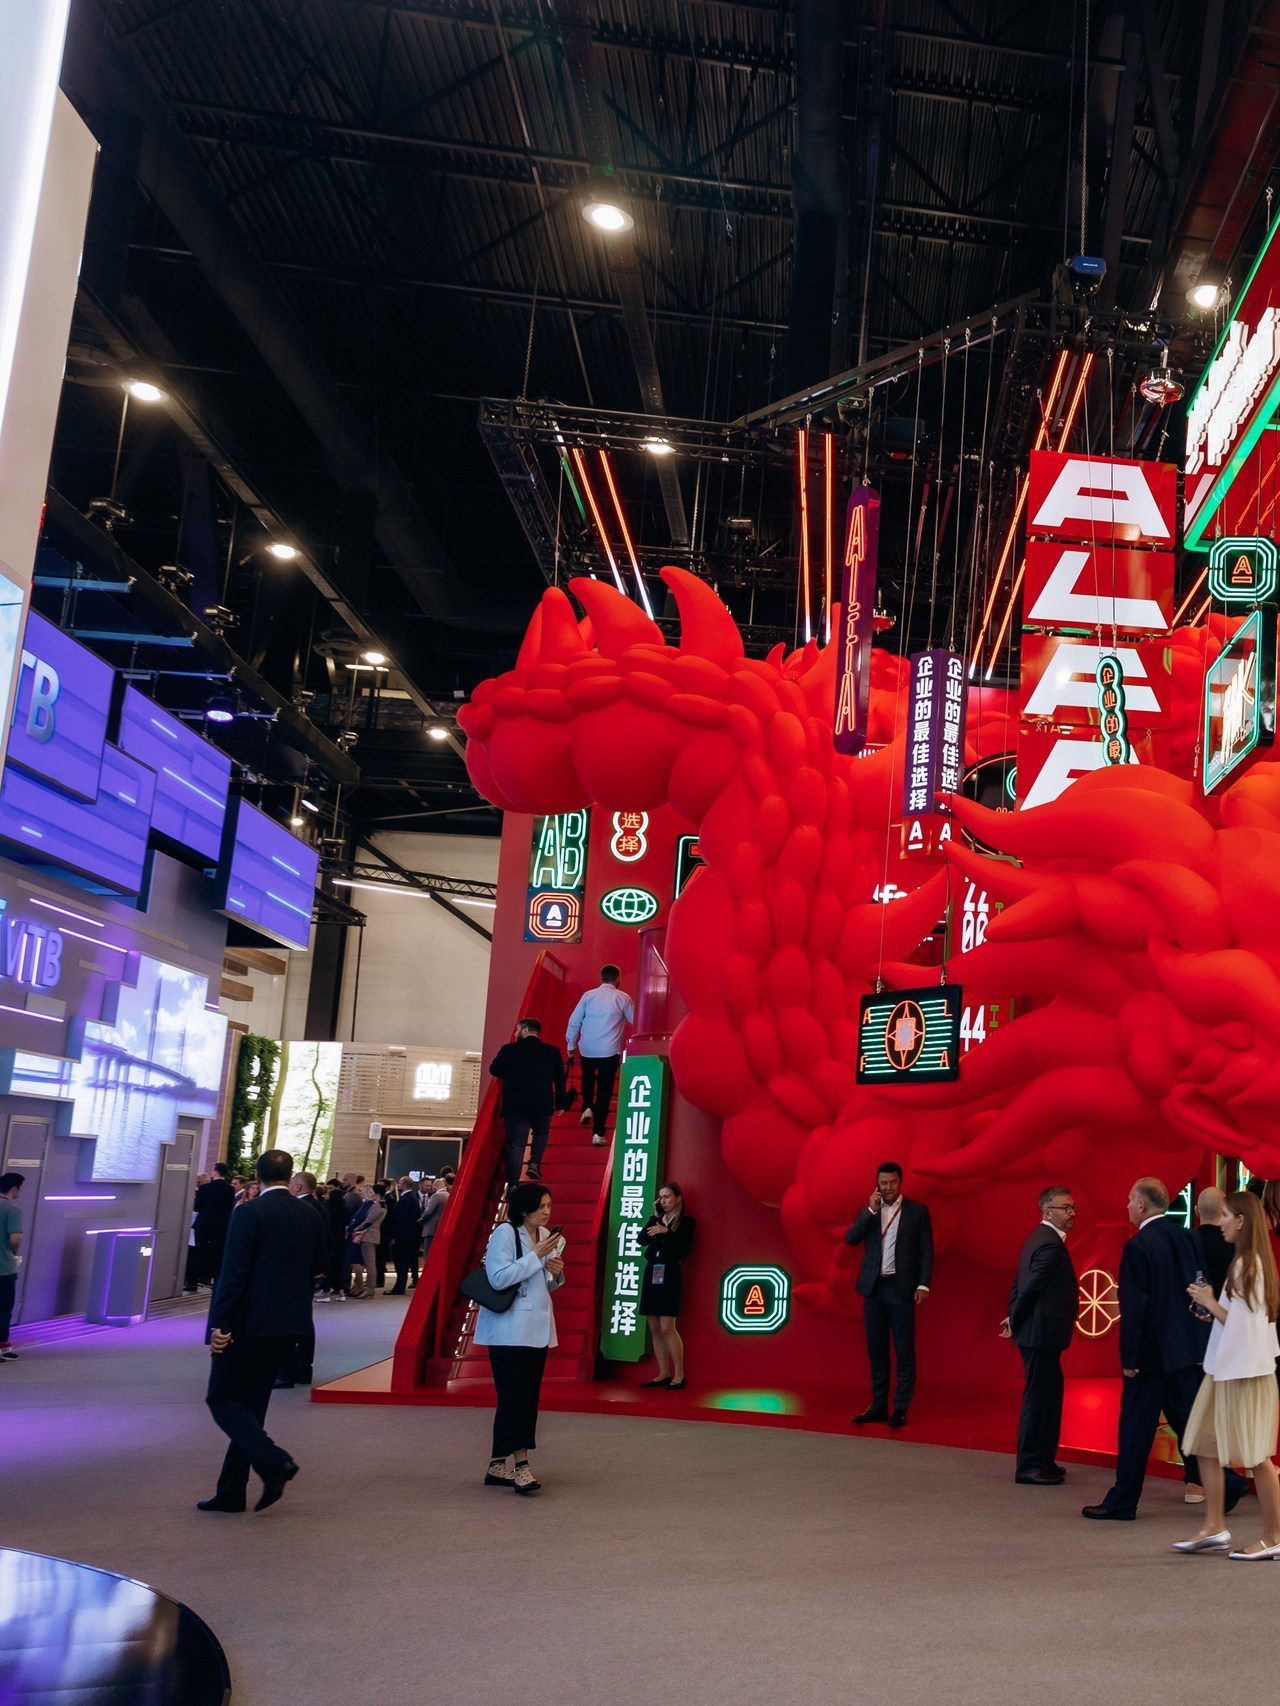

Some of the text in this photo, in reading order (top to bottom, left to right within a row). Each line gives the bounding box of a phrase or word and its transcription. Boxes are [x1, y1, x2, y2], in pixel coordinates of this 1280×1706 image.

[1233, 555, 1252, 574] A
[11, 648, 60, 743] TB
[909, 656, 933, 811] 企业的最佳选择
[940, 657, 962, 812] 企业的最佳选
[618, 812, 641, 853] 选择
[909, 820, 923, 842] A
[546, 904, 562, 919] A
[610, 1075, 651, 1336] 企业的最佳选择
[745, 1285, 764, 1305] A
